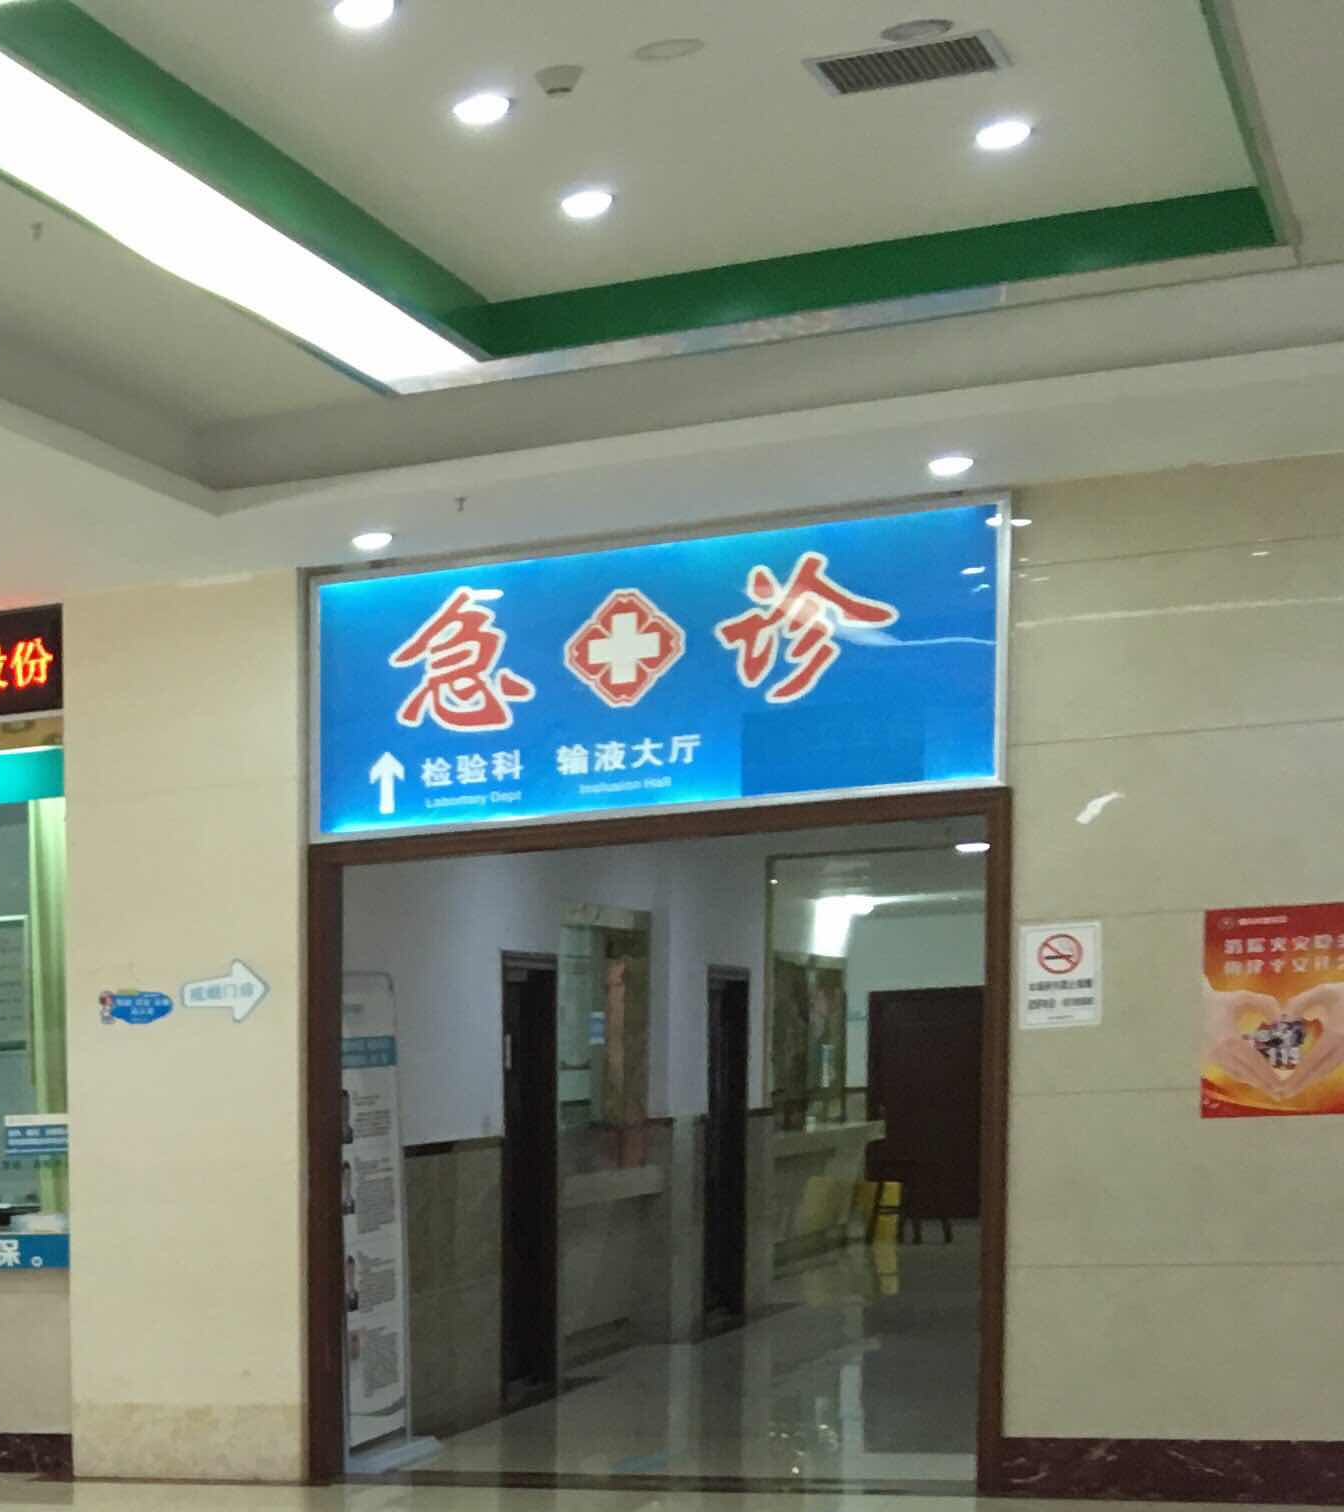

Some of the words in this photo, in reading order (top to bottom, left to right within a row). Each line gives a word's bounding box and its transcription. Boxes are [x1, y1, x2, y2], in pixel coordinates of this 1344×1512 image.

[420, 750, 523, 788] 检验科
[556, 734, 702, 775] 输液大厅
